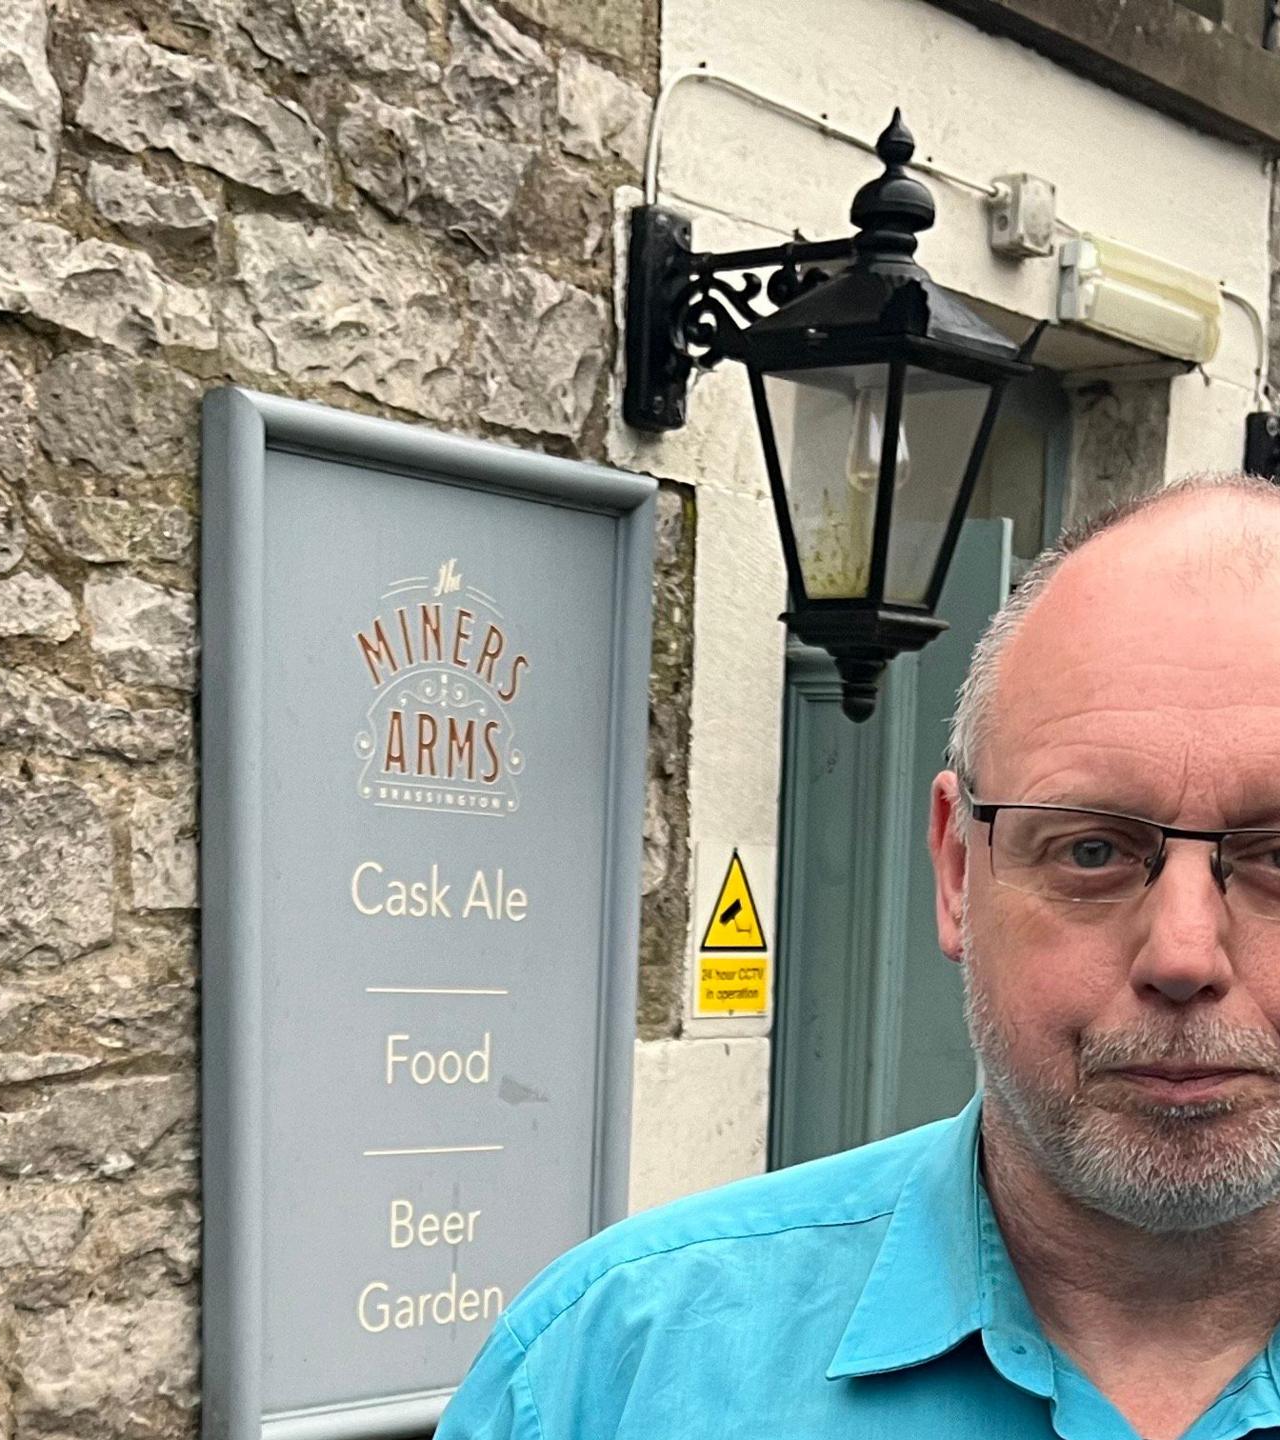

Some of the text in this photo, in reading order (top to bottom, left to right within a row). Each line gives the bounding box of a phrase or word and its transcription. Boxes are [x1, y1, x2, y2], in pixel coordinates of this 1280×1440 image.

[434, 560, 462, 597] The
[356, 604, 530, 704] MINERS
[384, 708, 501, 784] ARMS
[380, 788, 502, 808] BRASSINGTON
[351, 861, 528, 921] Cask Ale
[386, 1032, 493, 1085] Food
[389, 1199, 481, 1249] Beer
[358, 1273, 504, 1334] Garden
